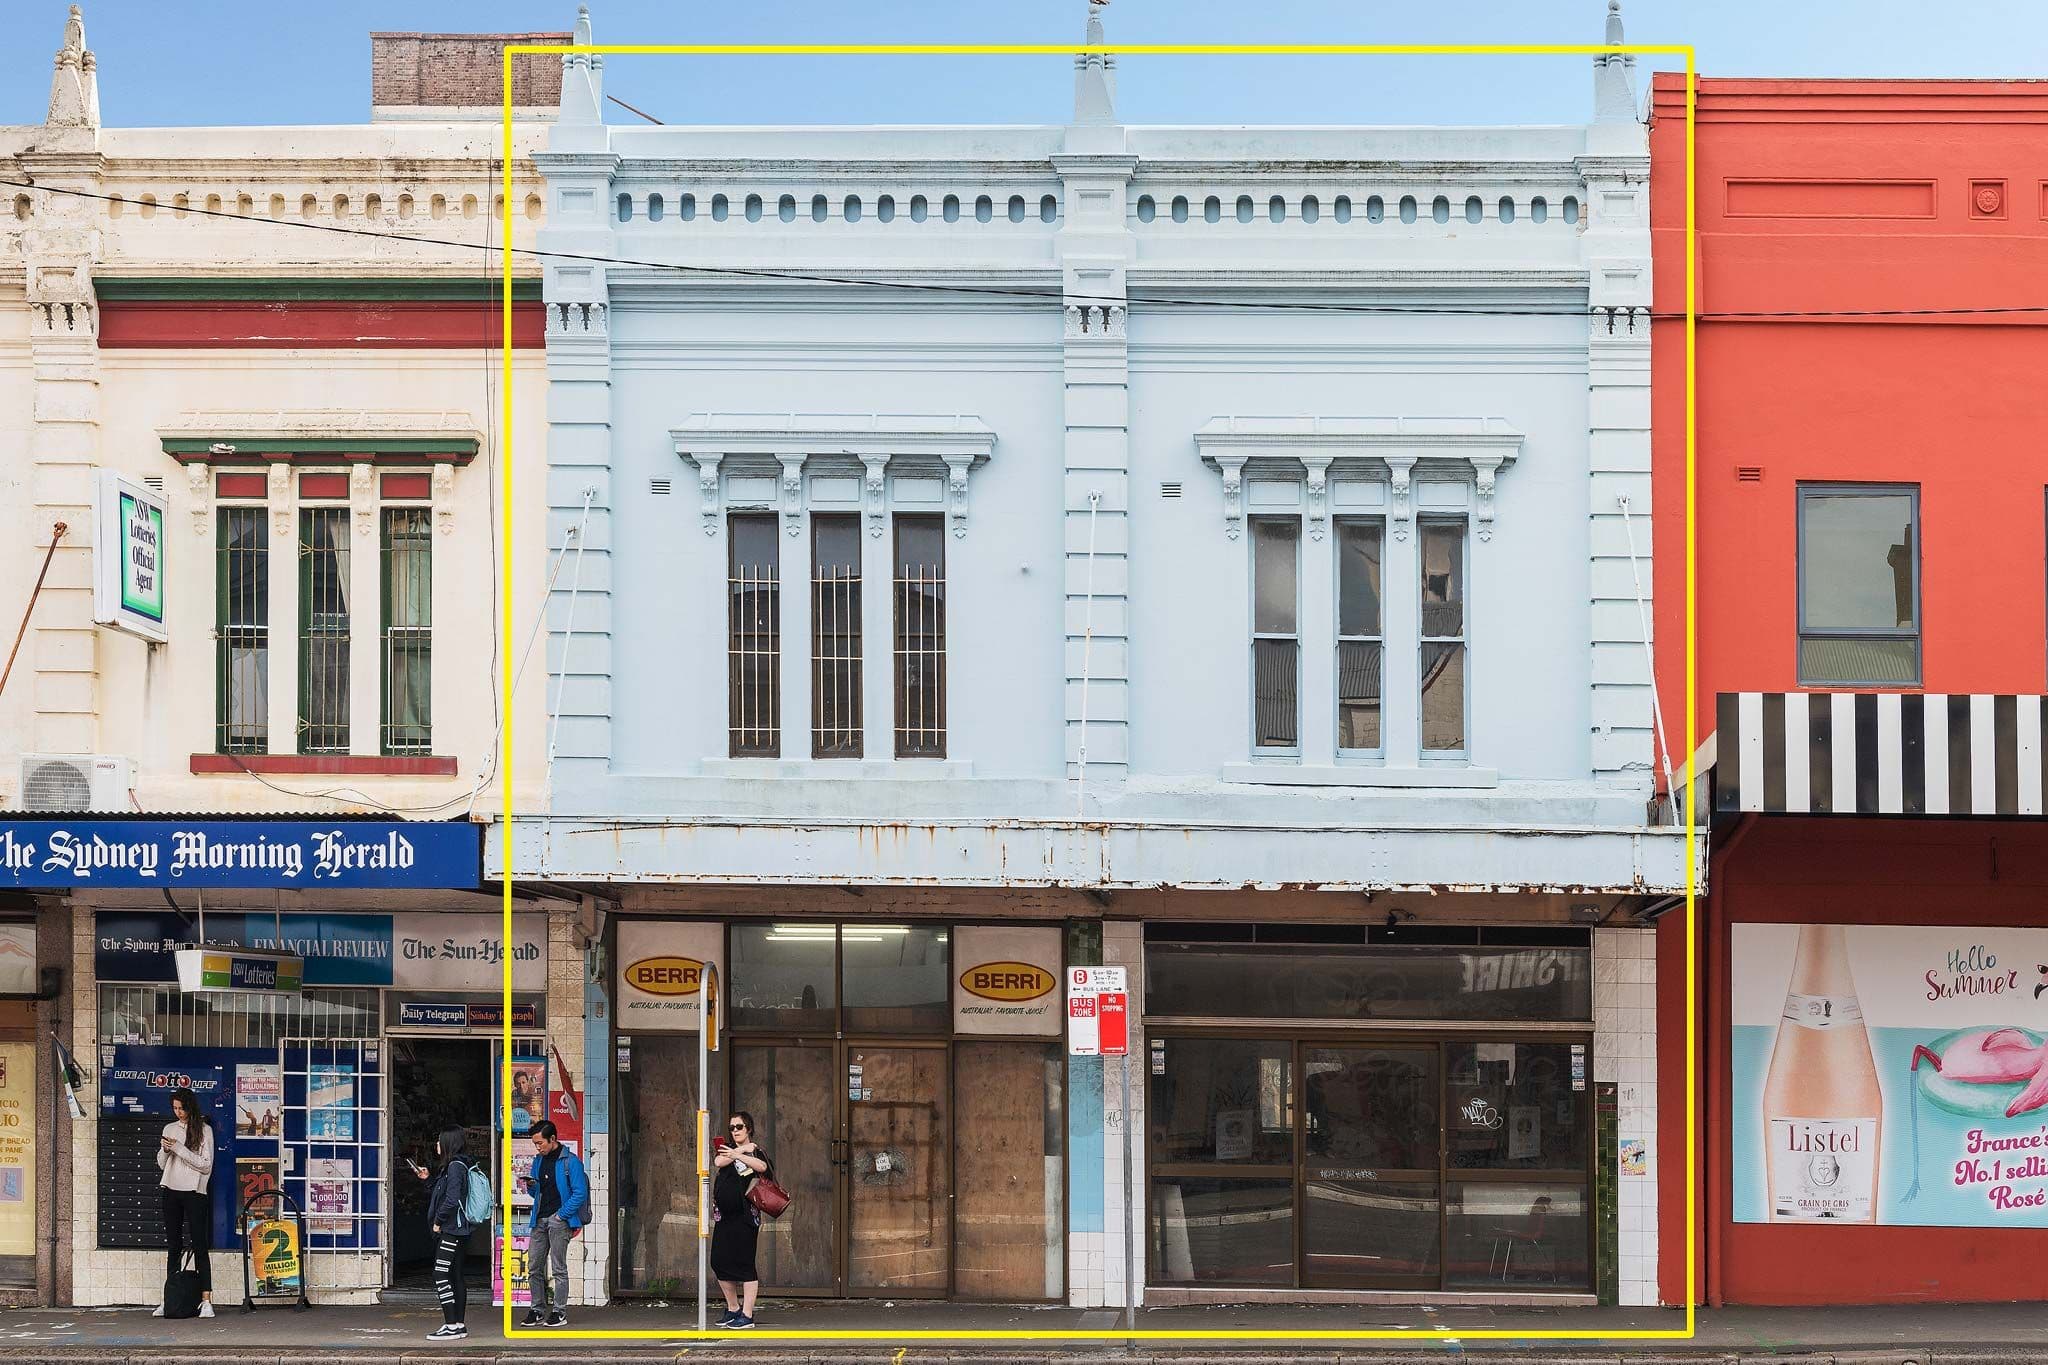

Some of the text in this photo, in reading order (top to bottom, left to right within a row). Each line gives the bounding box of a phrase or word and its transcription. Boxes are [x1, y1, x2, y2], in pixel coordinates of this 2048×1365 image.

[134, 498, 149, 522] NSW
[130, 519, 156, 549] Lotteries
[132, 545, 155, 571] Official
[135, 568, 153, 594] Agent
[42, 830, 159, 878] Sydney
[170, 831, 304, 878] Morning
[310, 830, 414, 879] Herald
[101, 938, 121, 953] The
[123, 937, 160, 953] Sydney
[333, 940, 390, 958] REVIEW
[402, 938, 540, 964] The Sun-Heald
[1947, 945, 1997, 974] Hello
[244, 963, 275, 985] Lotteries
[974, 972, 1041, 990] BERRI
[1925, 969, 2018, 1001] Summer
[662, 1001, 694, 1010] FAVOURITE
[994, 1007, 1025, 1015] FAVOURITE
[1072, 998, 1093, 1007] BUS
[402, 1009, 465, 1022] Daily Telegraph
[470, 1010, 533, 1022] Sunday Tgraph
[1073, 1008, 1093, 1017] ZONE
[114, 1070, 137, 1079] LIVE
[137, 1071, 147, 1079] A
[146, 1071, 191, 1088] Lotto
[6, 1137, 31, 1145] BREAD
[1788, 1124, 1859, 1152] Listel
[5, 1146, 23, 1154] PANE
[1955, 1158, 2000, 1185] No.1
[1798, 1199, 1849, 1208] GRAIN DE GRIS
[1988, 1185, 2047, 1210] Rosé
[264, 1260, 297, 1270] MILLION
[434, 1259, 451, 1272] DO
